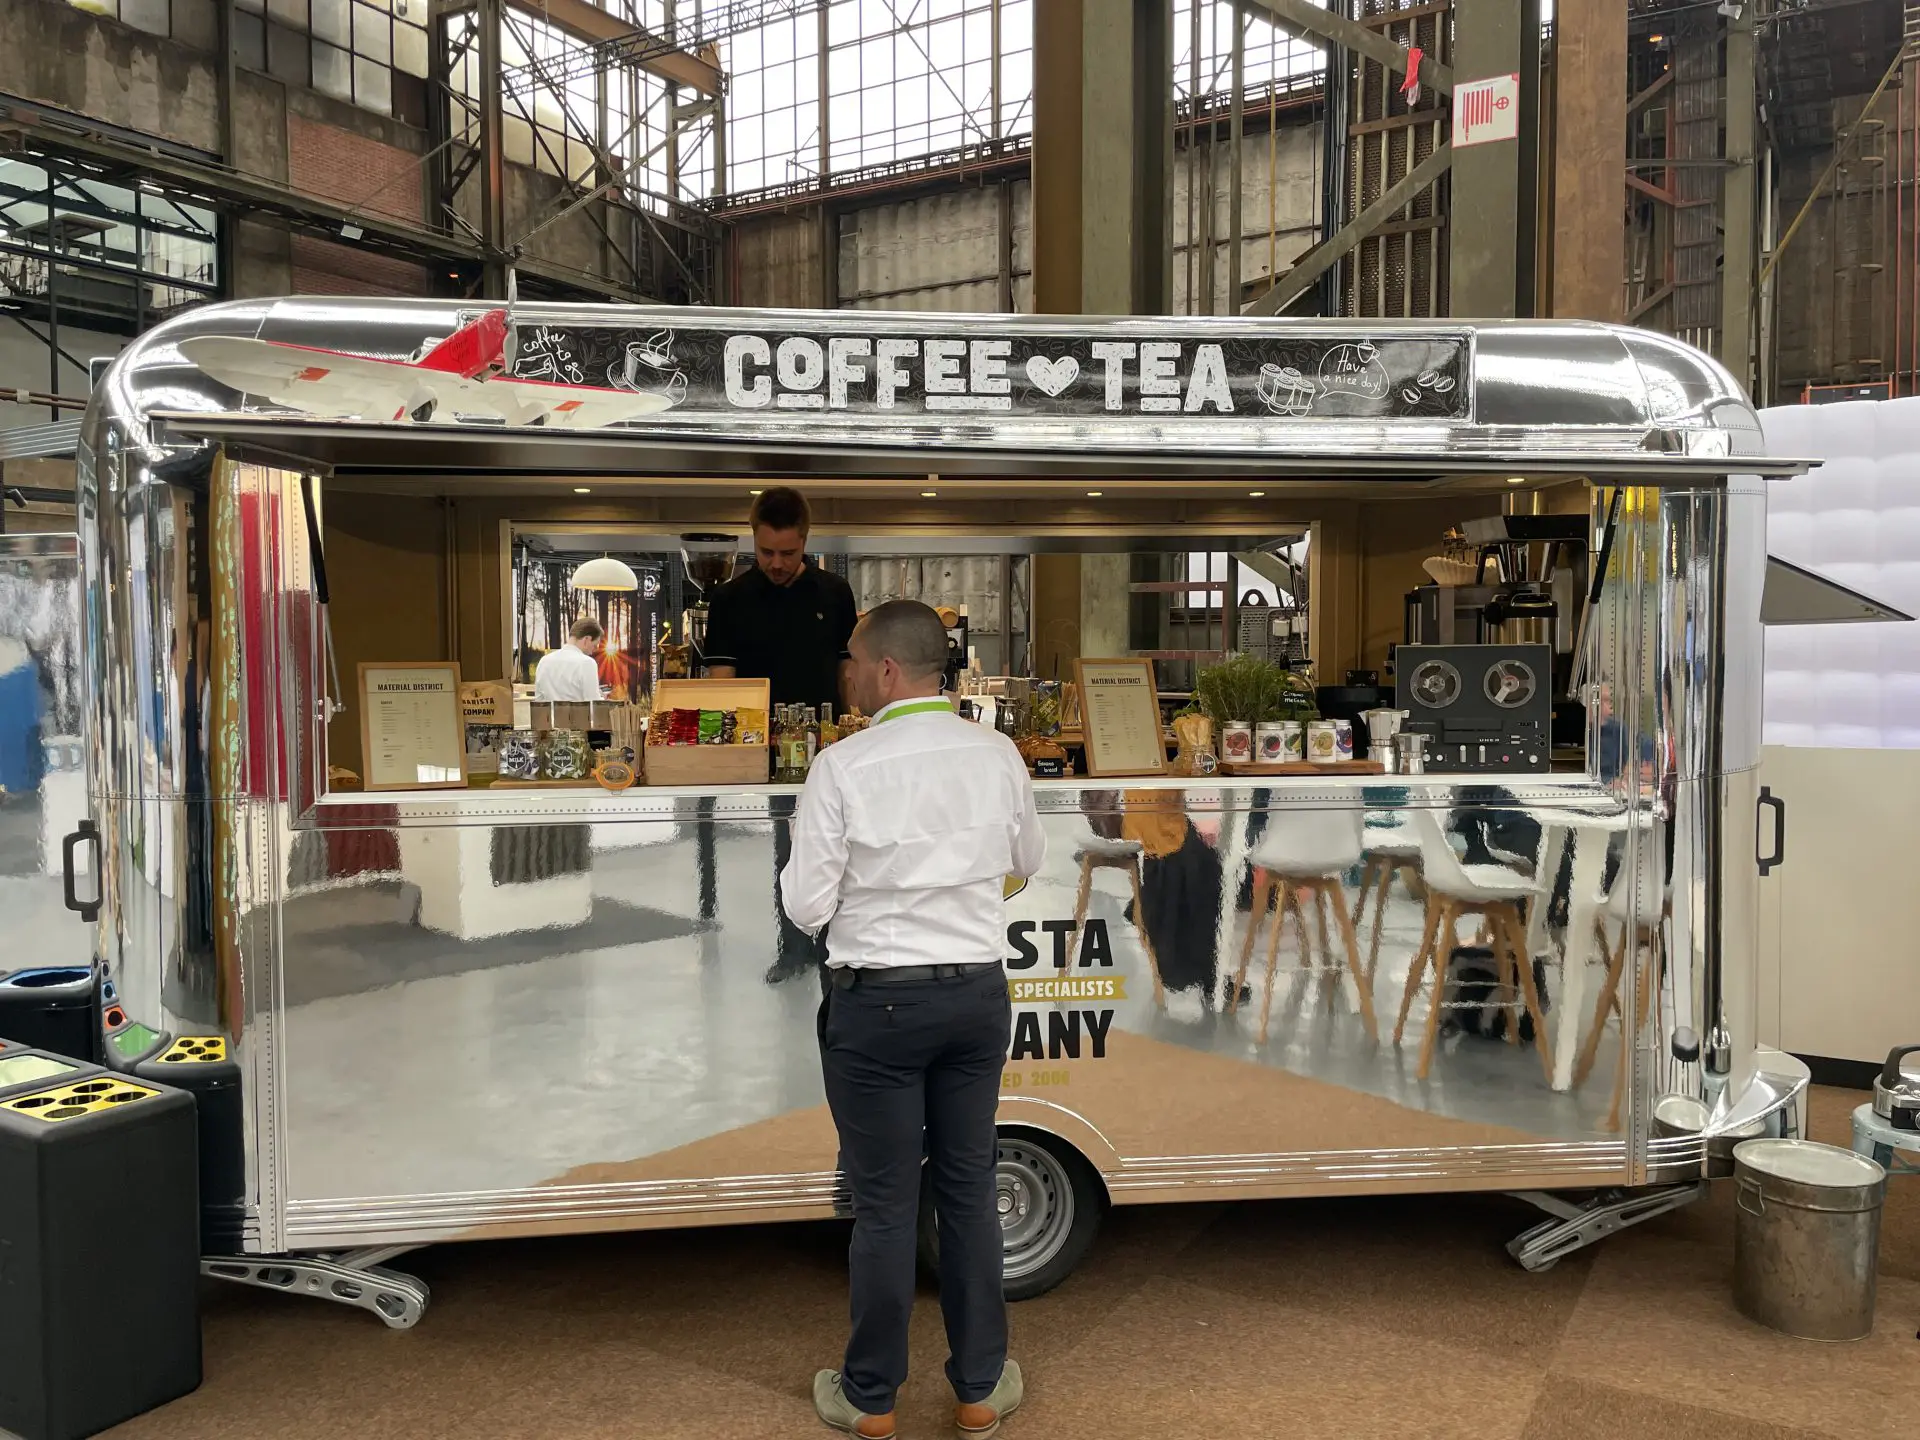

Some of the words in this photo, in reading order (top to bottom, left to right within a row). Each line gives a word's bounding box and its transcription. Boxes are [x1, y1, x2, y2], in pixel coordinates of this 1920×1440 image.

[523, 326, 566, 352] coffee
[556, 344, 571, 361] to
[1337, 345, 1368, 374] Have
[564, 362, 584, 383] go
[724, 335, 1012, 409] COFFEE
[1091, 342, 1235, 412] TEA
[1323, 374, 1331, 382] a
[1335, 374, 1357, 386] nice
[1361, 374, 1383, 394] day!
[377, 683, 411, 691] MATERIAL
[1091, 677, 1117, 685] MATERIAL
[1118, 677, 1141, 685] DISTRICT
[462, 697, 495, 705] BARISTA
[463, 708, 495, 716] COMPANY
[1006, 918, 1114, 970] STA
[1014, 980, 1115, 999] SPECIALISTS
[1010, 1009, 1115, 1061] ANY
